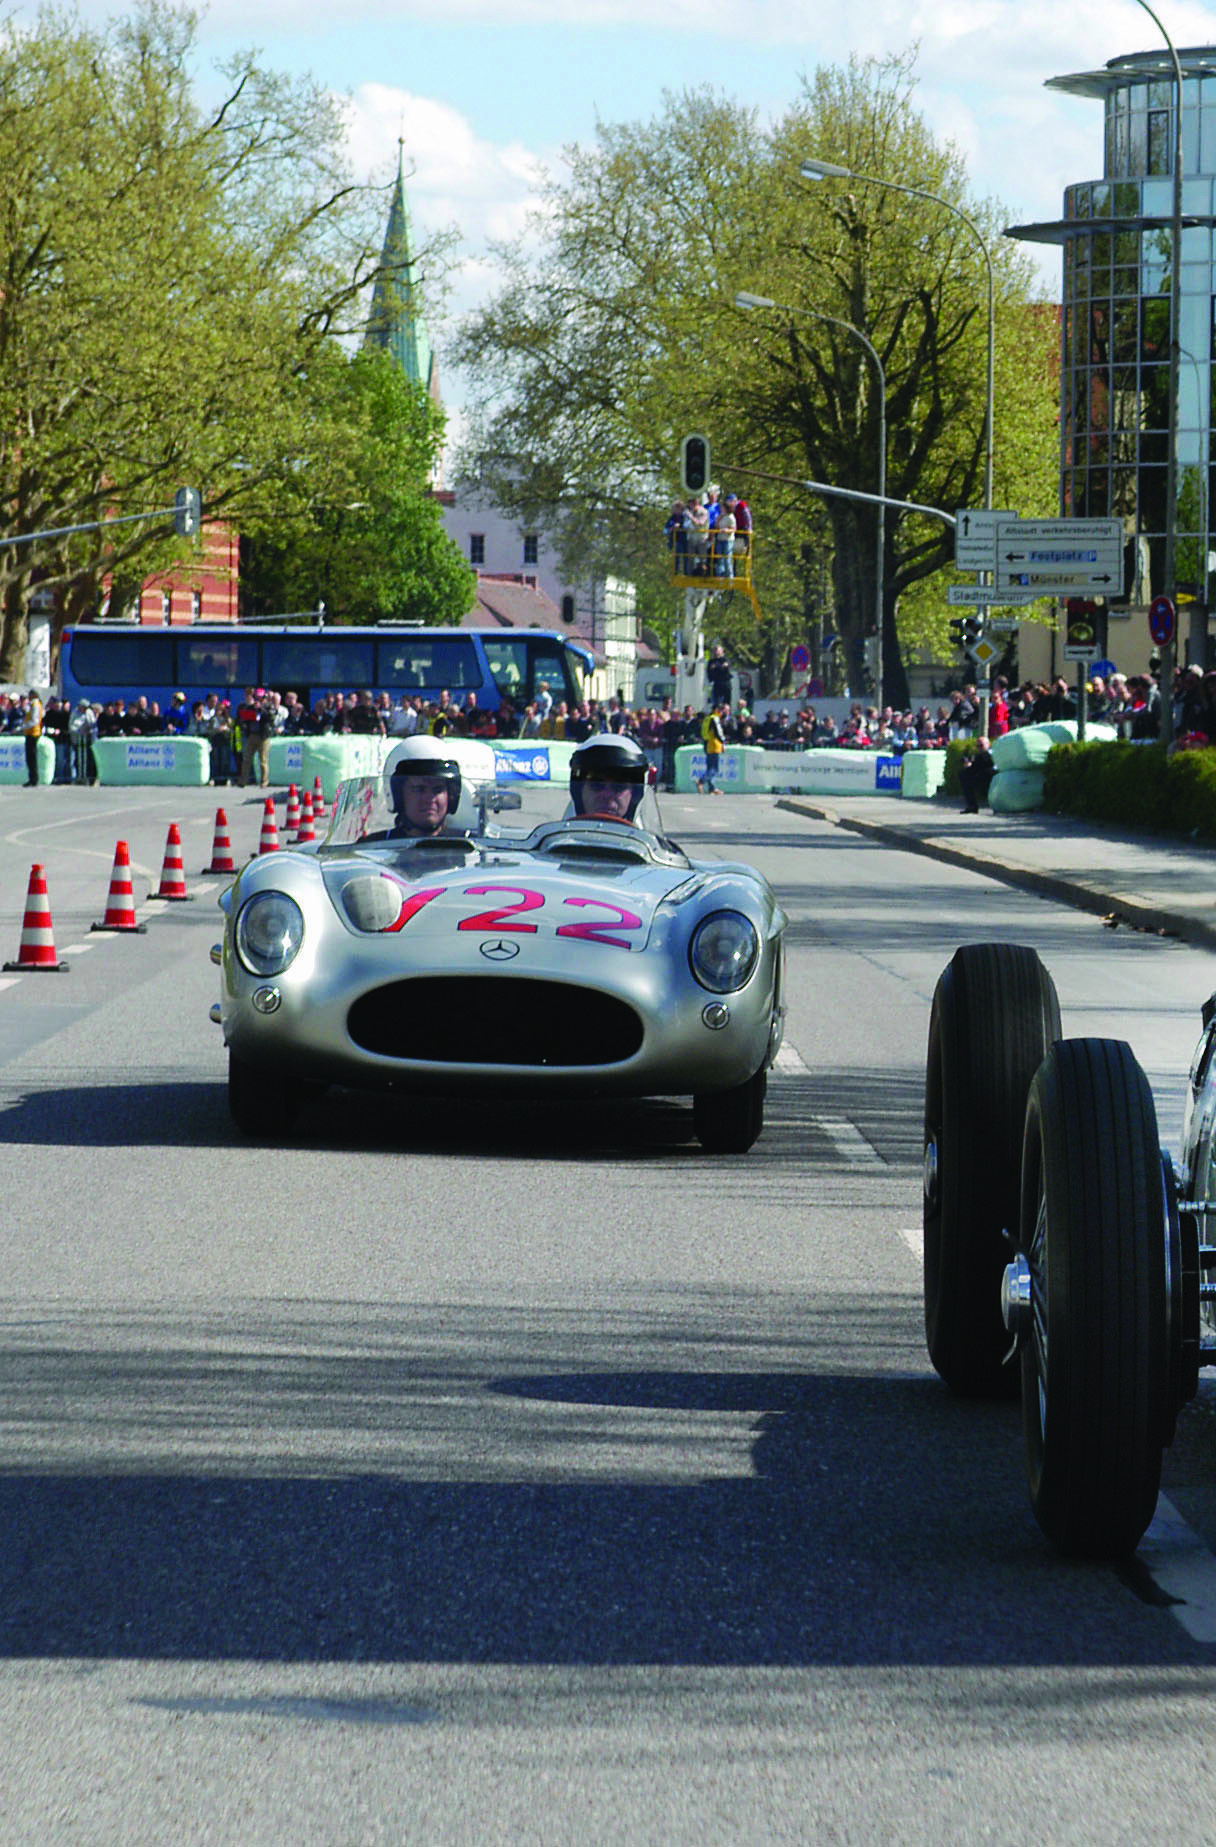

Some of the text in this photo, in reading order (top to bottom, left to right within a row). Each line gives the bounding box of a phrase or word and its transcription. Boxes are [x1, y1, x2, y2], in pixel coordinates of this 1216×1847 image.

[1030, 551, 1084, 562] Festplatz
[1030, 575, 1074, 585] Münster
[128, 746, 160, 755] Allianz
[128, 758, 160, 768] Allianz
[380, 872, 643, 950] 722
